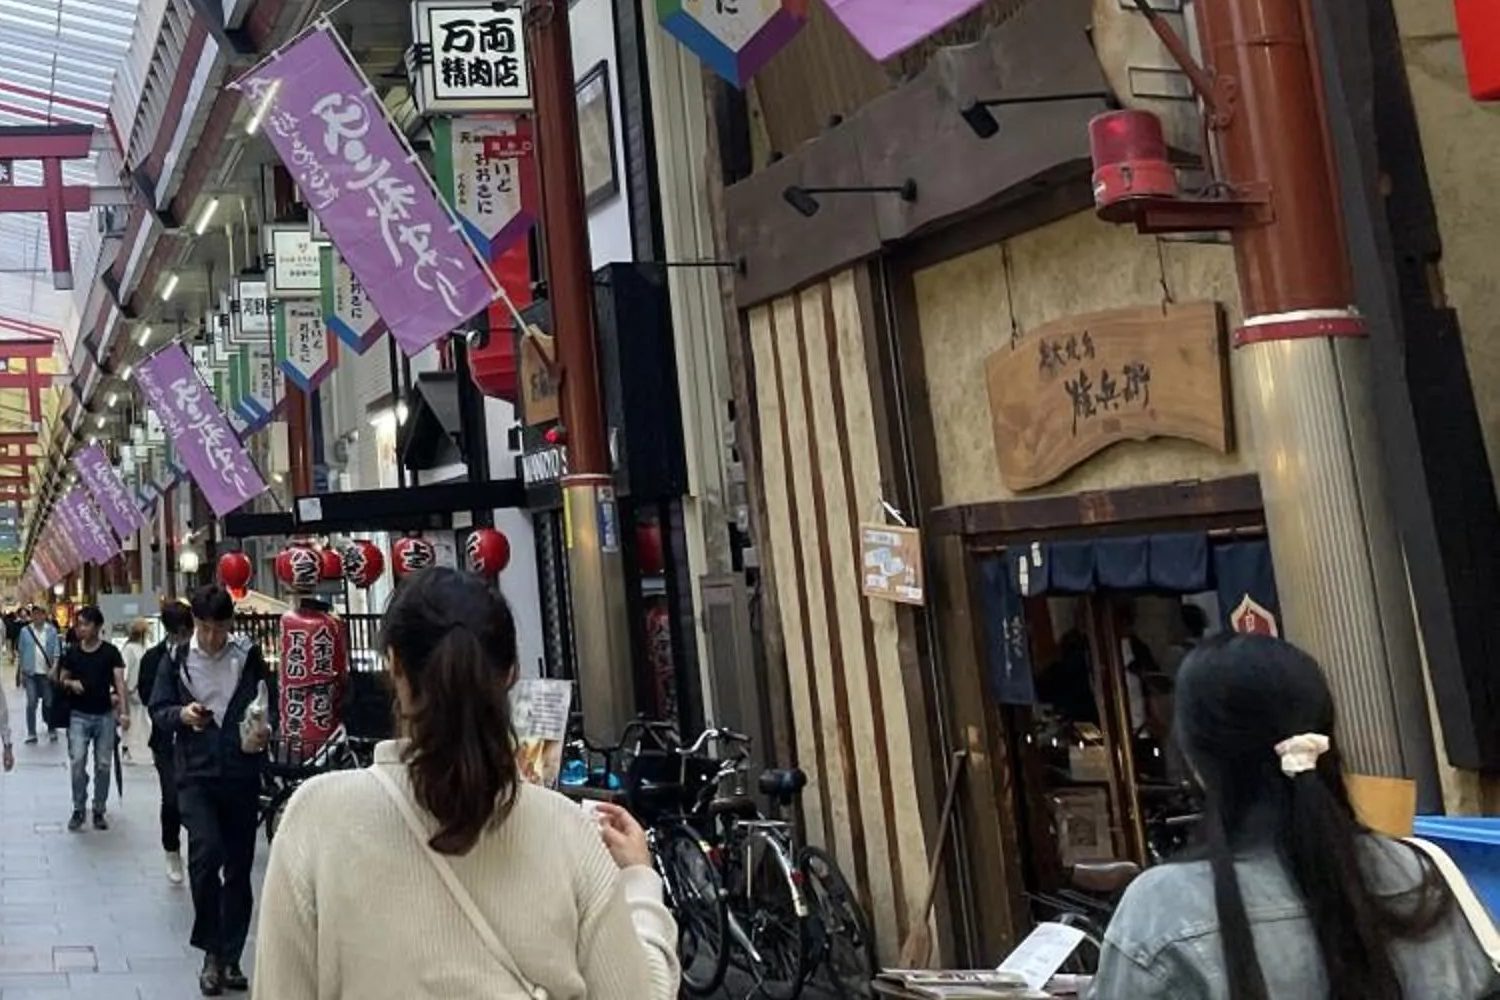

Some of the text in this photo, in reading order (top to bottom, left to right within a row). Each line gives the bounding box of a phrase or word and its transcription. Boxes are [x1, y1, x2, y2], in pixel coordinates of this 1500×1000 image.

[439, 17, 515, 53] 万両
[441, 56, 519, 88] 精肉店
[494, 161, 511, 193] いど
